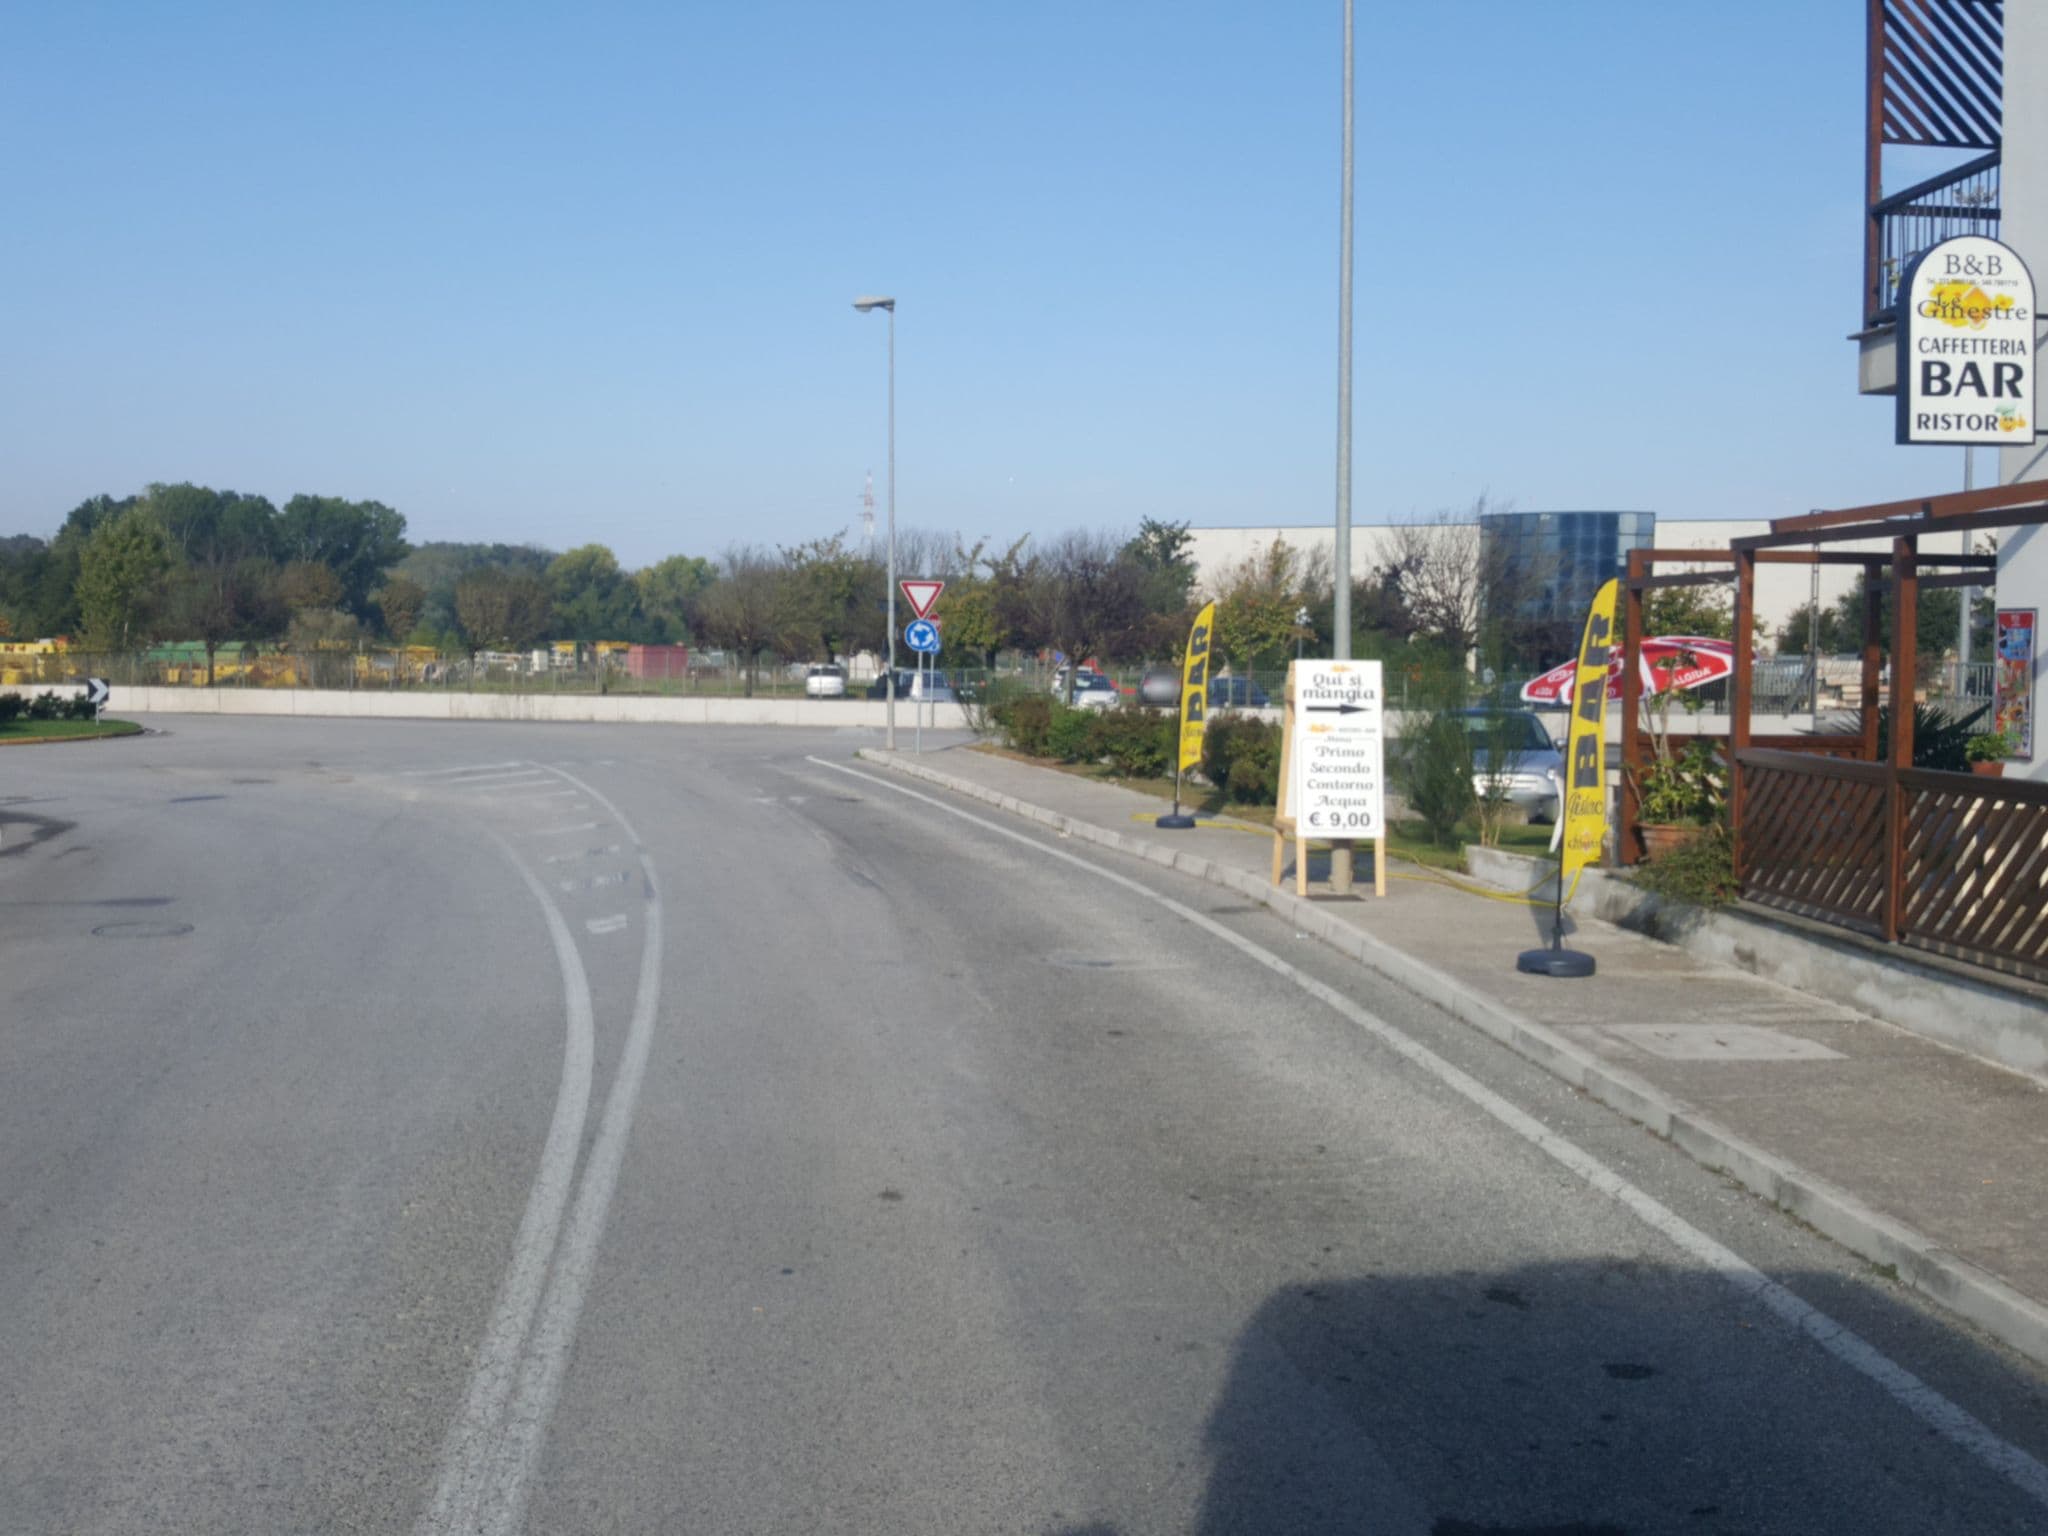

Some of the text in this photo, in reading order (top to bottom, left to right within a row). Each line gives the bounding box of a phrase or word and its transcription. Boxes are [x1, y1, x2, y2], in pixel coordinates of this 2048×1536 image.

[1944, 253, 2003, 276] B&B
[1917, 299, 2028, 321] Ginestre
[1918, 336, 2027, 356] CAFFETTERIA
[1920, 360, 2024, 398] BAR
[1312, 673, 1362, 688] Qui si
[1302, 687, 1375, 703] mangia
[1574, 613, 1609, 788] BAR
[1315, 745, 1365, 758] Primo
[1310, 762, 1370, 775] Secondo
[1307, 778, 1374, 791] Contorno
[1314, 794, 1367, 808] Acqua
[1309, 812, 1371, 829] € 9,00
